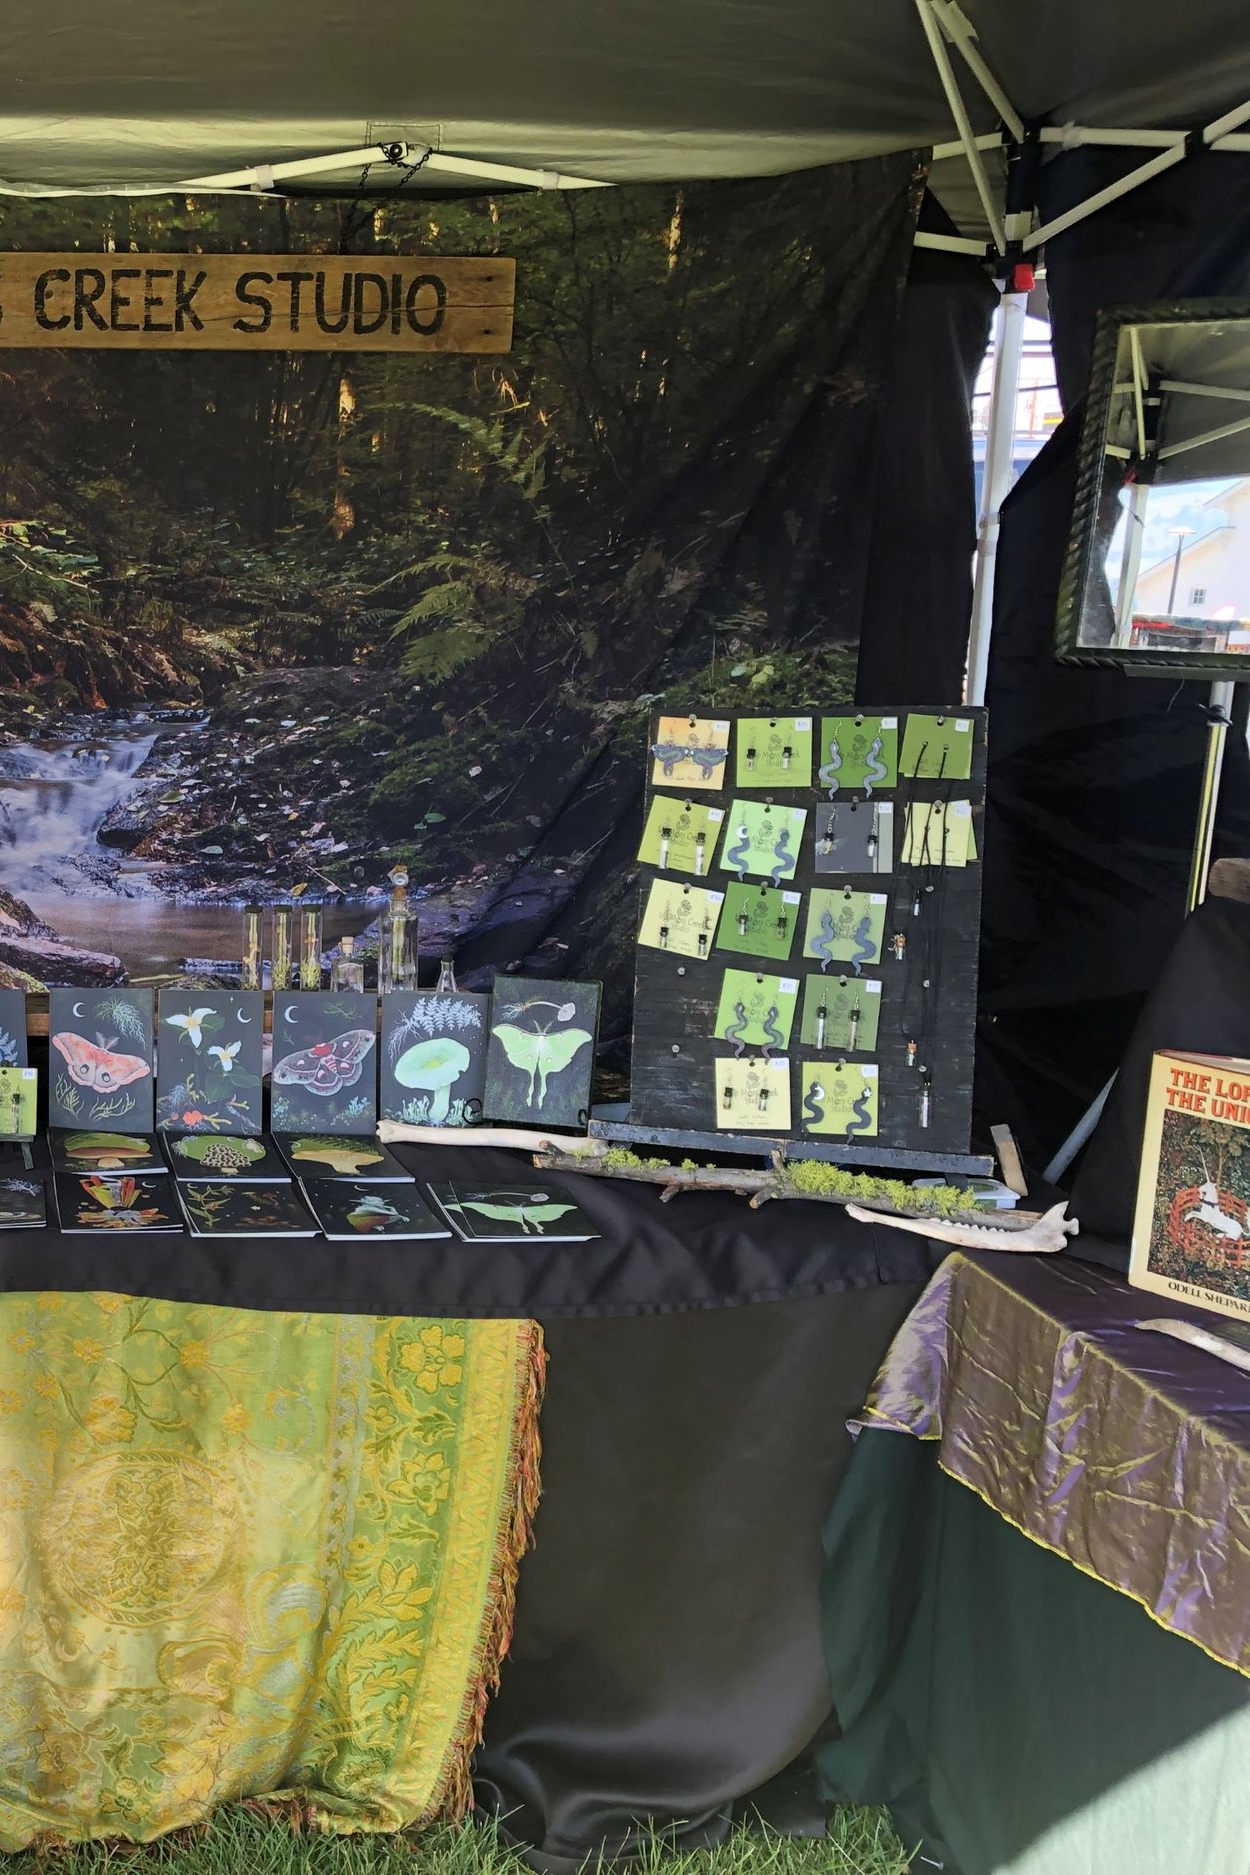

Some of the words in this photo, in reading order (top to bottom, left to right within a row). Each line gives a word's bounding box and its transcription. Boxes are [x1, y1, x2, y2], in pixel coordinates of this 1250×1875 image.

[34, 268, 207, 332] CREEK
[233, 271, 447, 336] STUDIO
[1171, 1068, 1211, 1094] THE
[1166, 1087, 1206, 1114] THE
[1168, 1281, 1203, 1299] ODELL
[1204, 1291, 1250, 1314] SHEPAR
